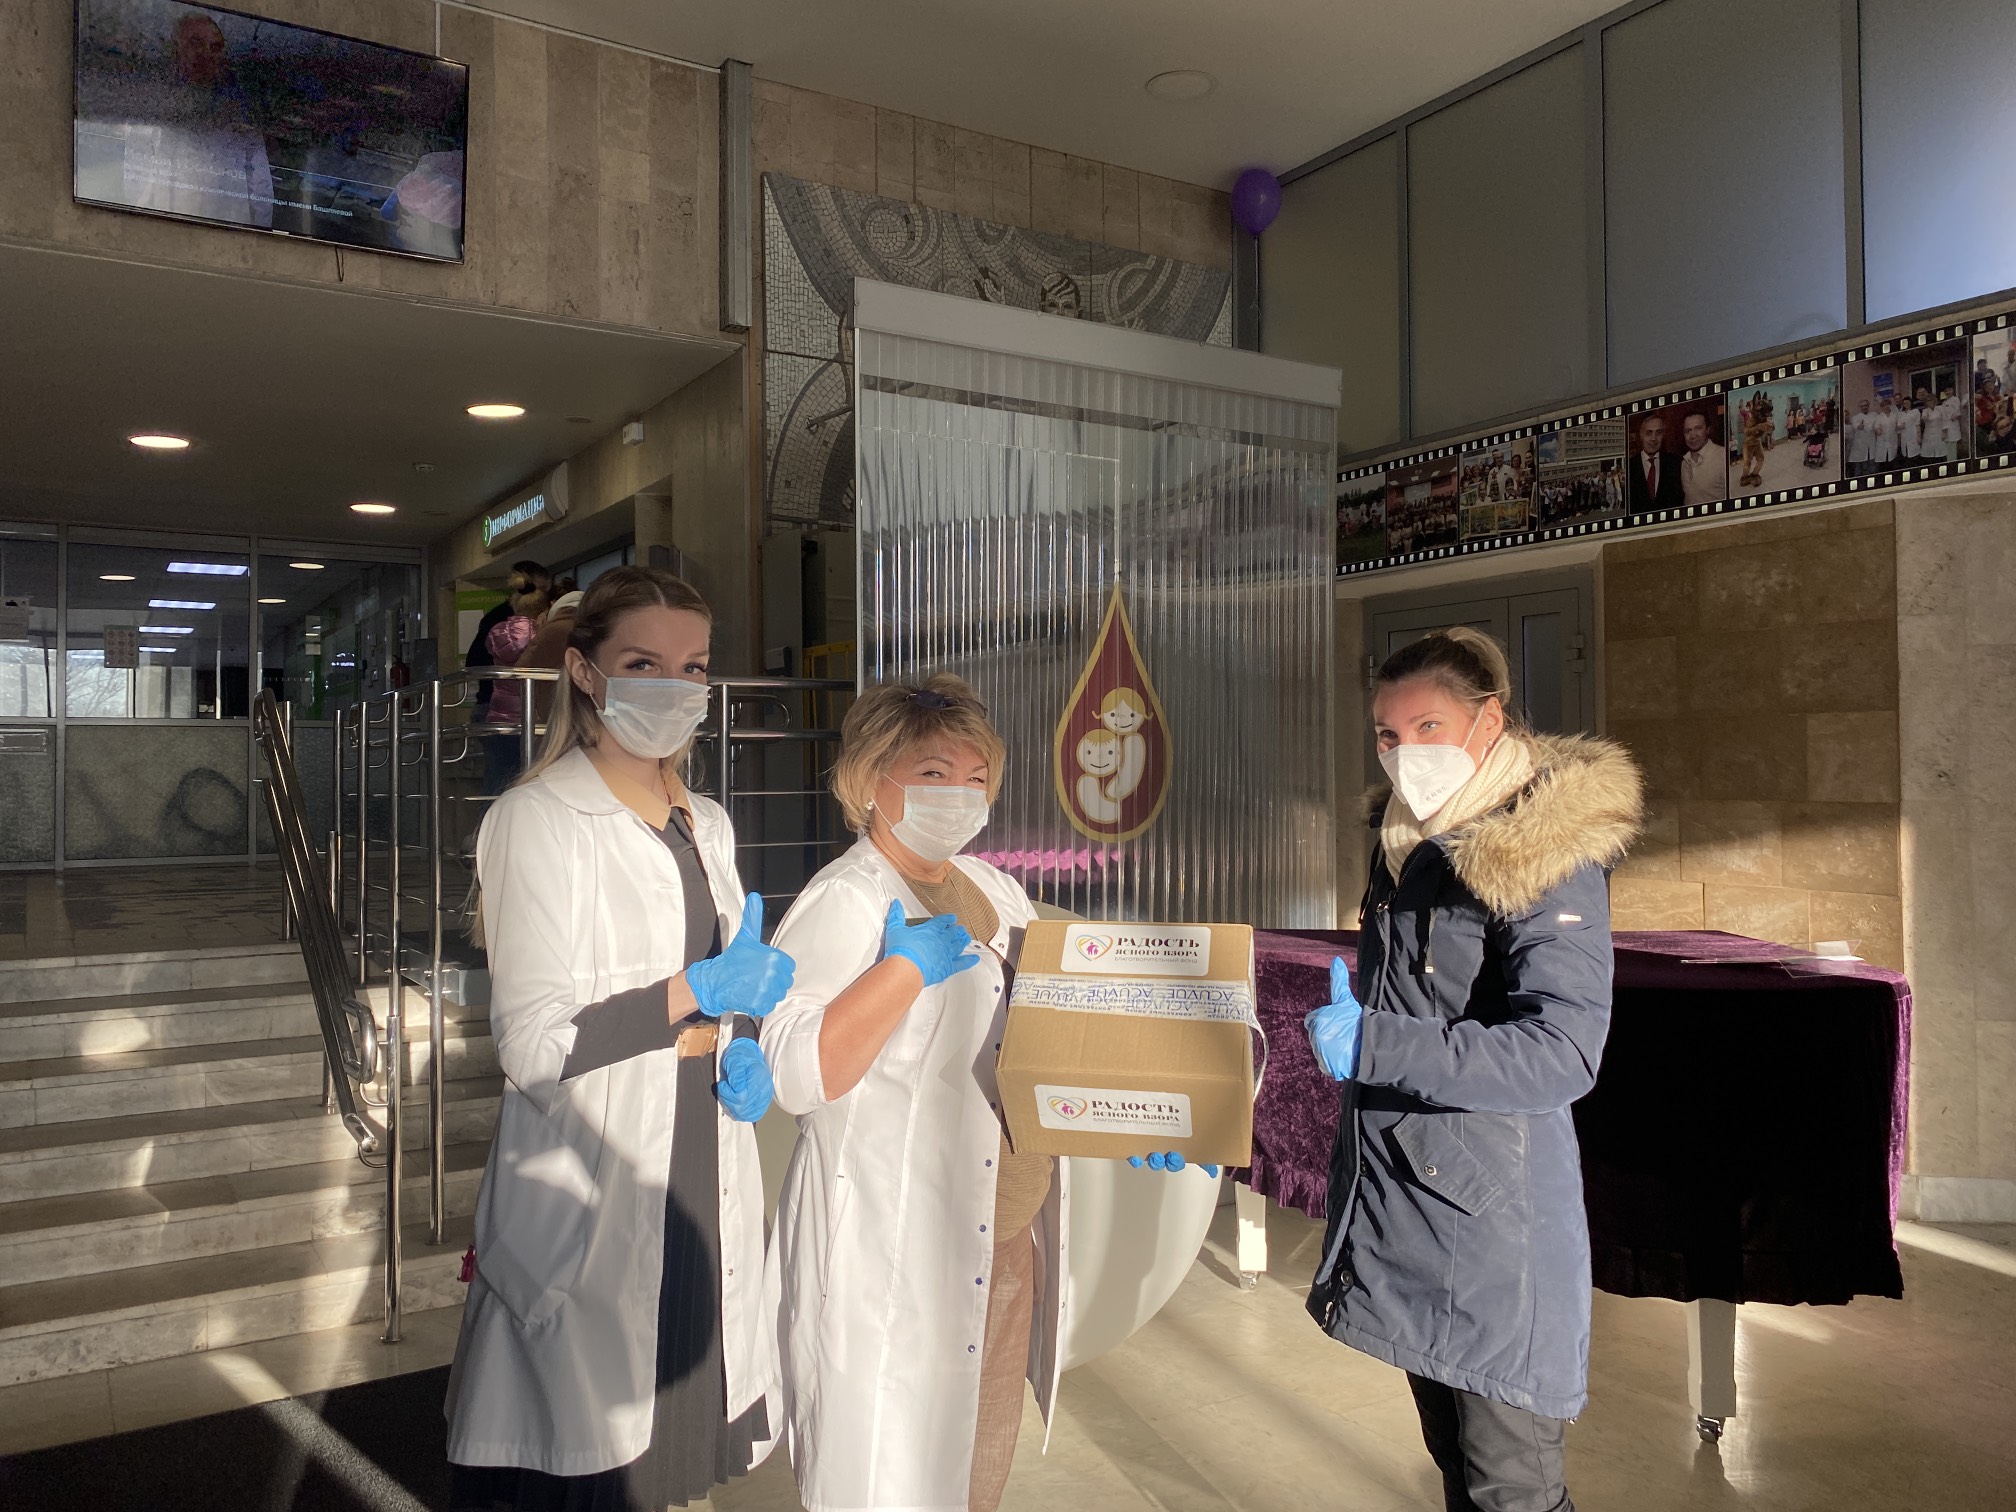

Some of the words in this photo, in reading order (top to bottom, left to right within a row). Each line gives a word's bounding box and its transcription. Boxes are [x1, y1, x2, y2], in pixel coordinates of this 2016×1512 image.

[1117, 937, 1200, 949] РАДОСТЬ
[1114, 949, 1160, 957] ЯСНОГО
[1088, 988, 1154, 999] ACUVUE
[1167, 989, 1235, 1001] ACUVUE
[1091, 1101, 1180, 1113] РАДОСТЬ
[1092, 1111, 1139, 1119] ЯСНОГО
[1142, 1114, 1180, 1122] ВЗОРА
